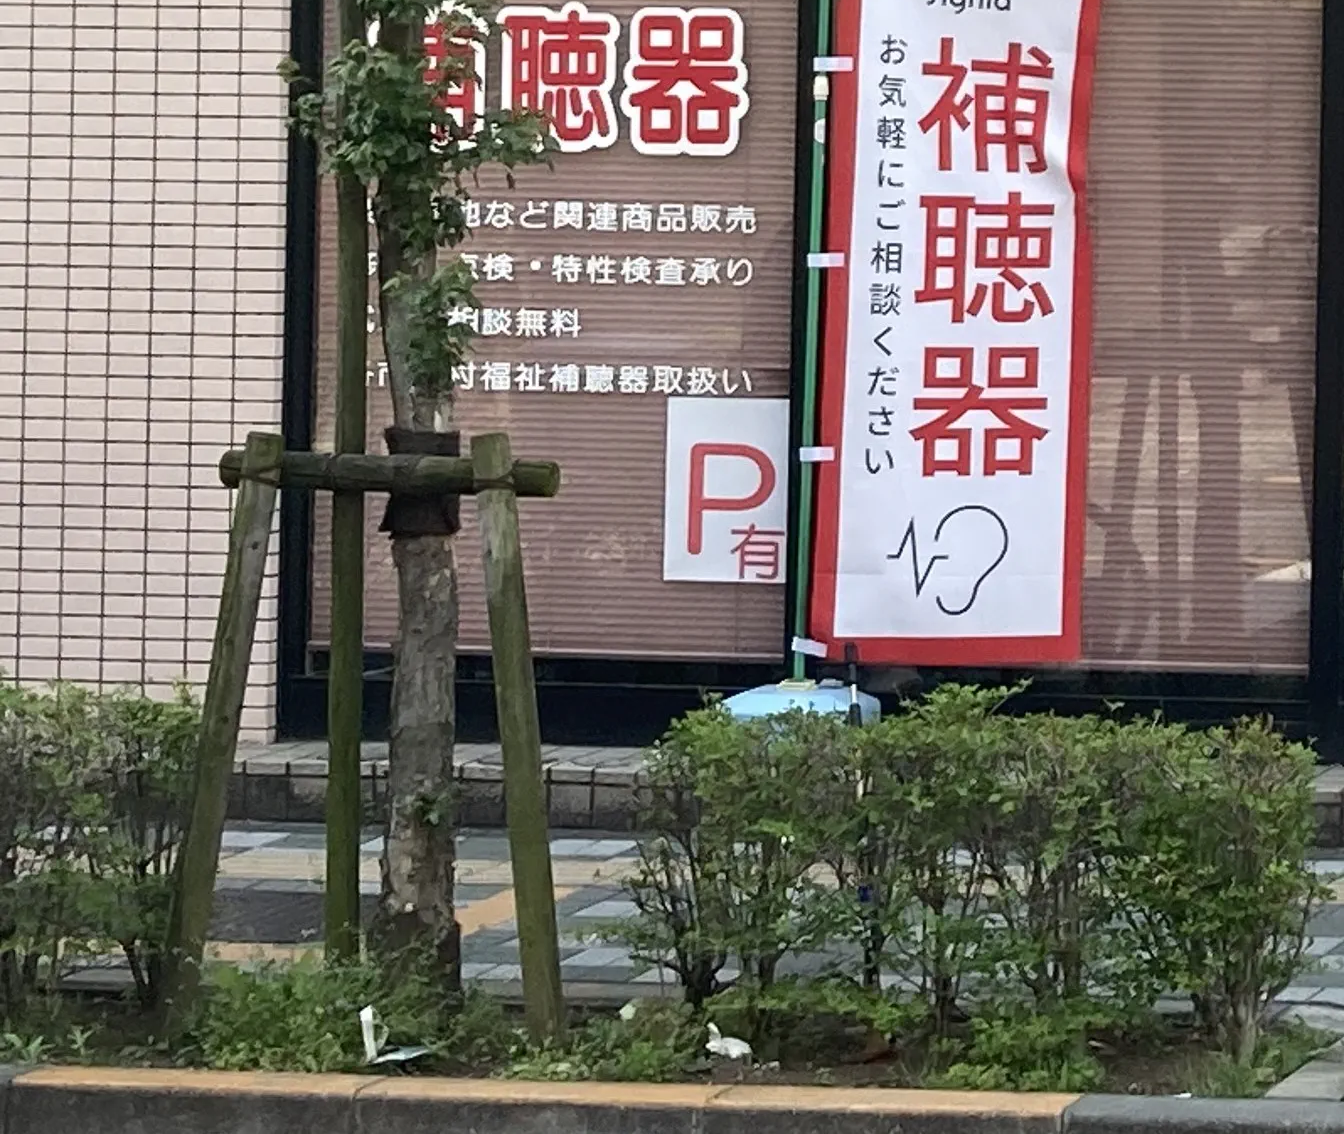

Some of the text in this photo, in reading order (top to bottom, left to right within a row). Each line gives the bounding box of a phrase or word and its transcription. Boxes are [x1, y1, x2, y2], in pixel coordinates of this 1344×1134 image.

[865, 35, 908, 475] お気軽にご相談ください
[908, 37, 1054, 477] 補聴器
[687, 442, 785, 581] P 有
